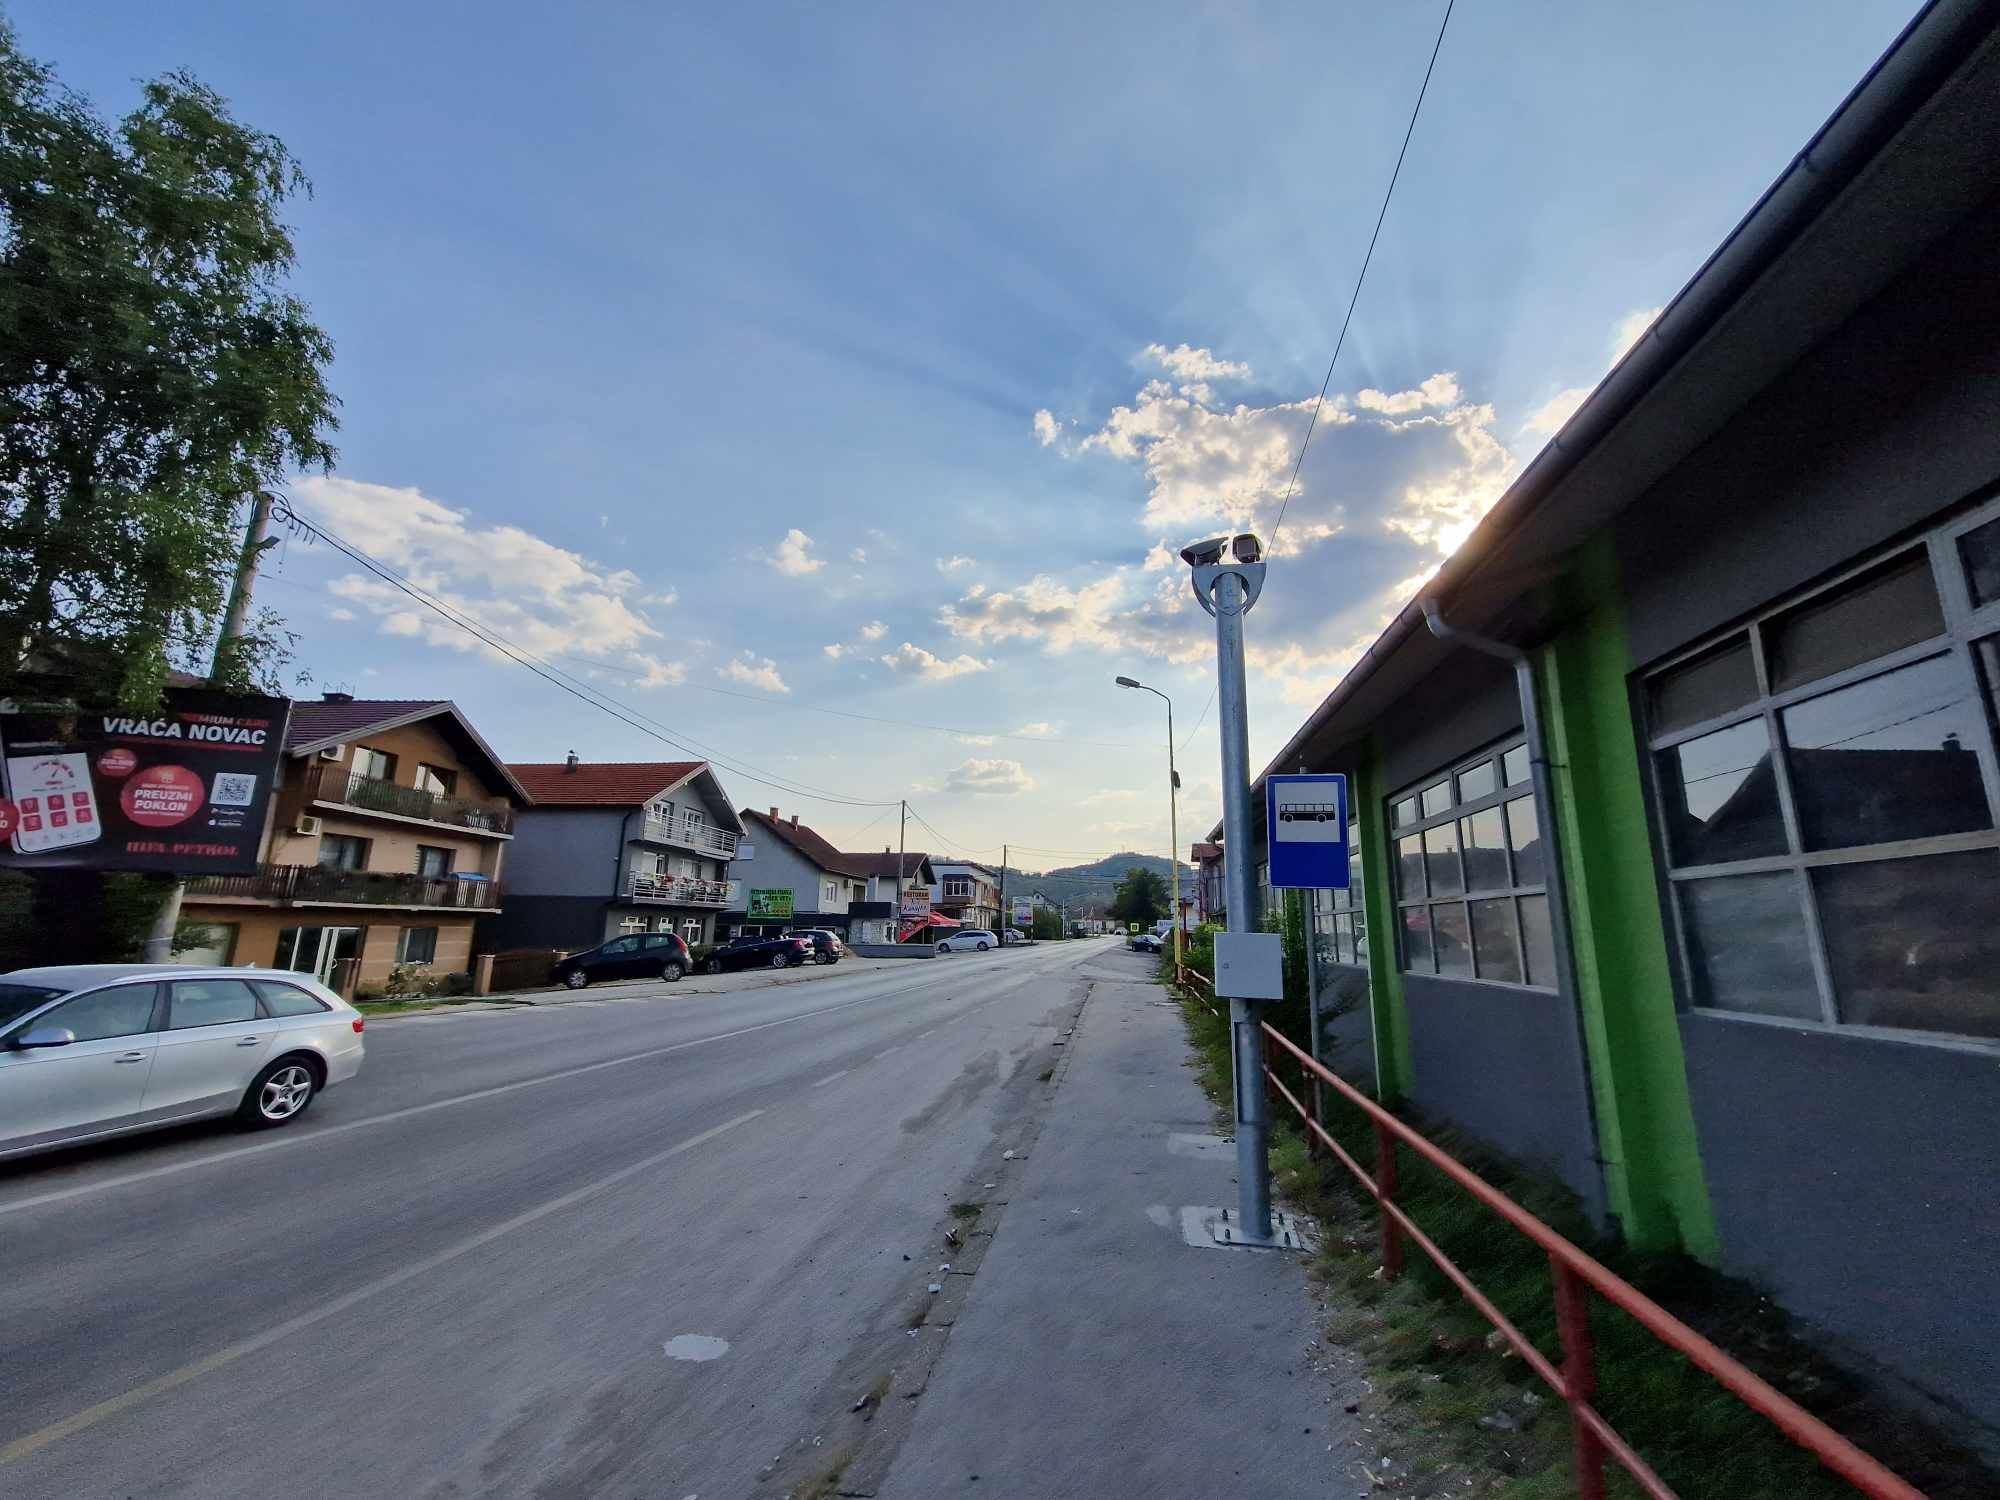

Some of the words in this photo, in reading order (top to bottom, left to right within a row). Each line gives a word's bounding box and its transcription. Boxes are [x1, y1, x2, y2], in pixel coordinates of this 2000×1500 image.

[103, 717, 182, 738] VRAĆA
[188, 724, 267, 745] NOVAC
[134, 789, 192, 801] PREUZMI
[134, 800, 188, 811] POKLON
